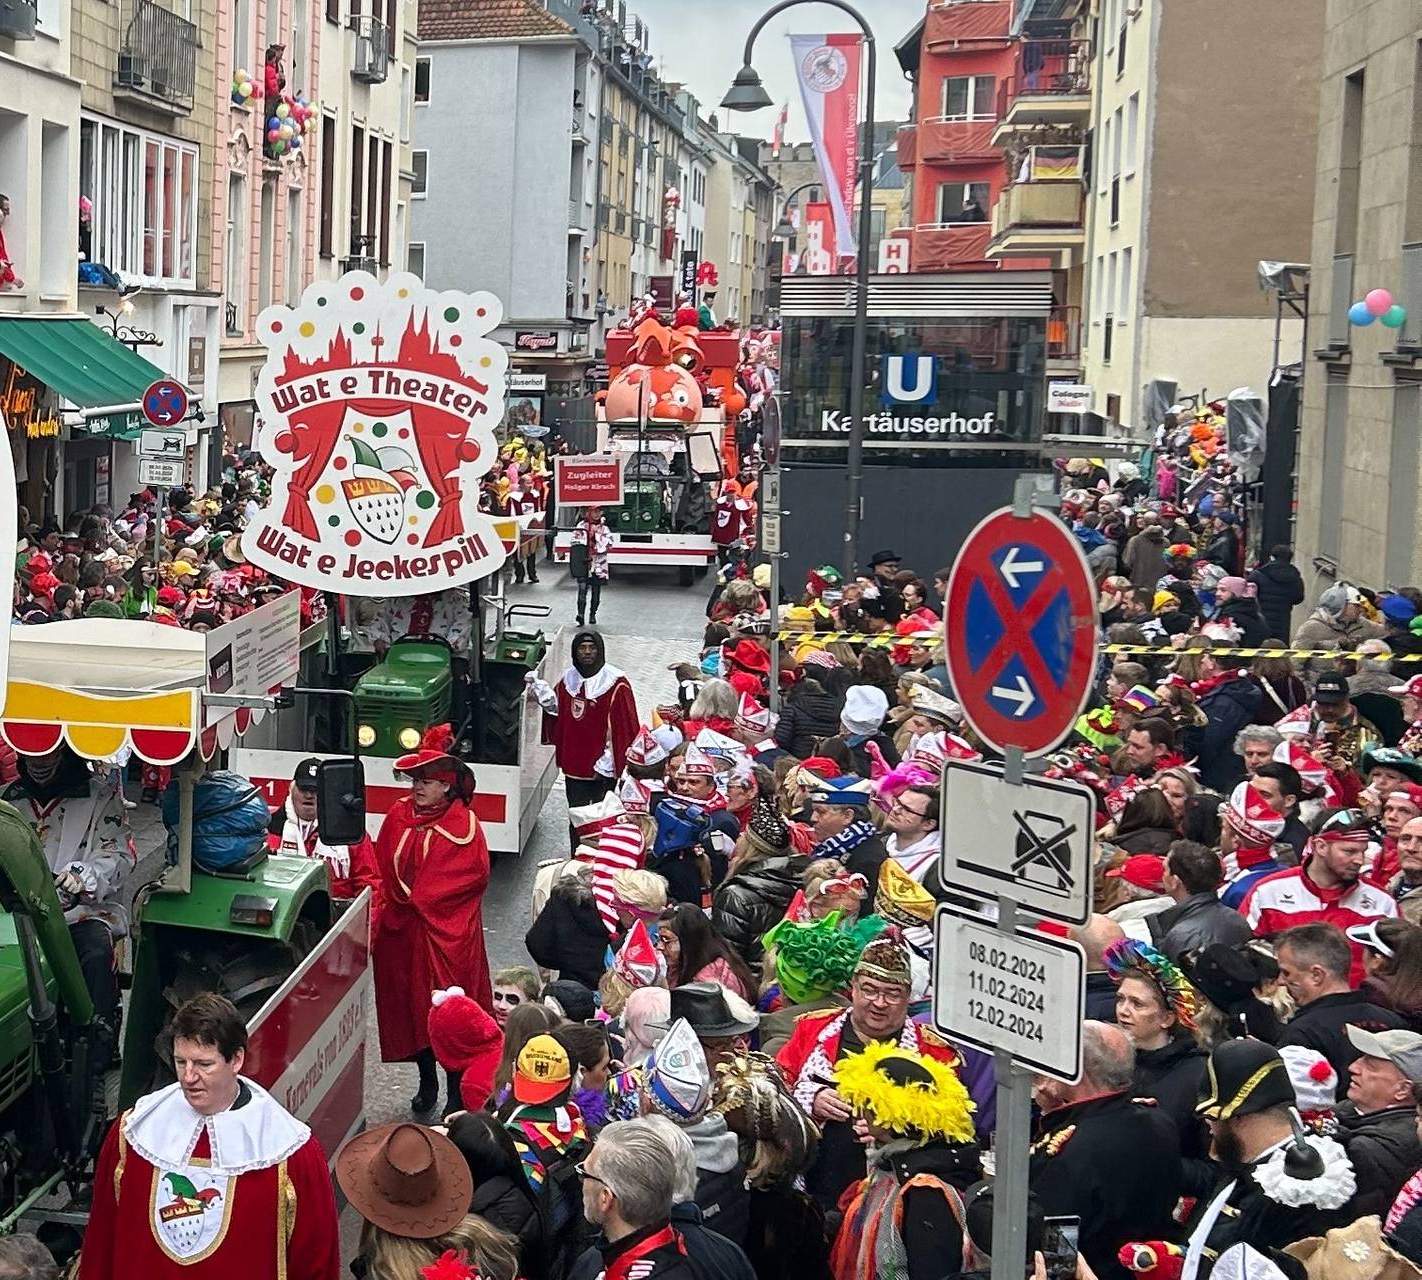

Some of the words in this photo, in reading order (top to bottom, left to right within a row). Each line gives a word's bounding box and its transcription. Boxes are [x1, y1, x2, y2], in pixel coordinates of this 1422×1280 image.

[271, 377, 331, 413] Wat
[340, 375, 358, 395] e
[368, 370, 489, 419] Theater
[887, 356, 934, 401] U
[256, 525, 313, 568] Wat
[318, 554, 336, 575] e
[342, 533, 489, 581] Jeckespill
[969, 941, 1046, 984] 08.02.2024
[968, 970, 1045, 1014] 11.02.2024
[968, 999, 1044, 1043] 12.02.2024
